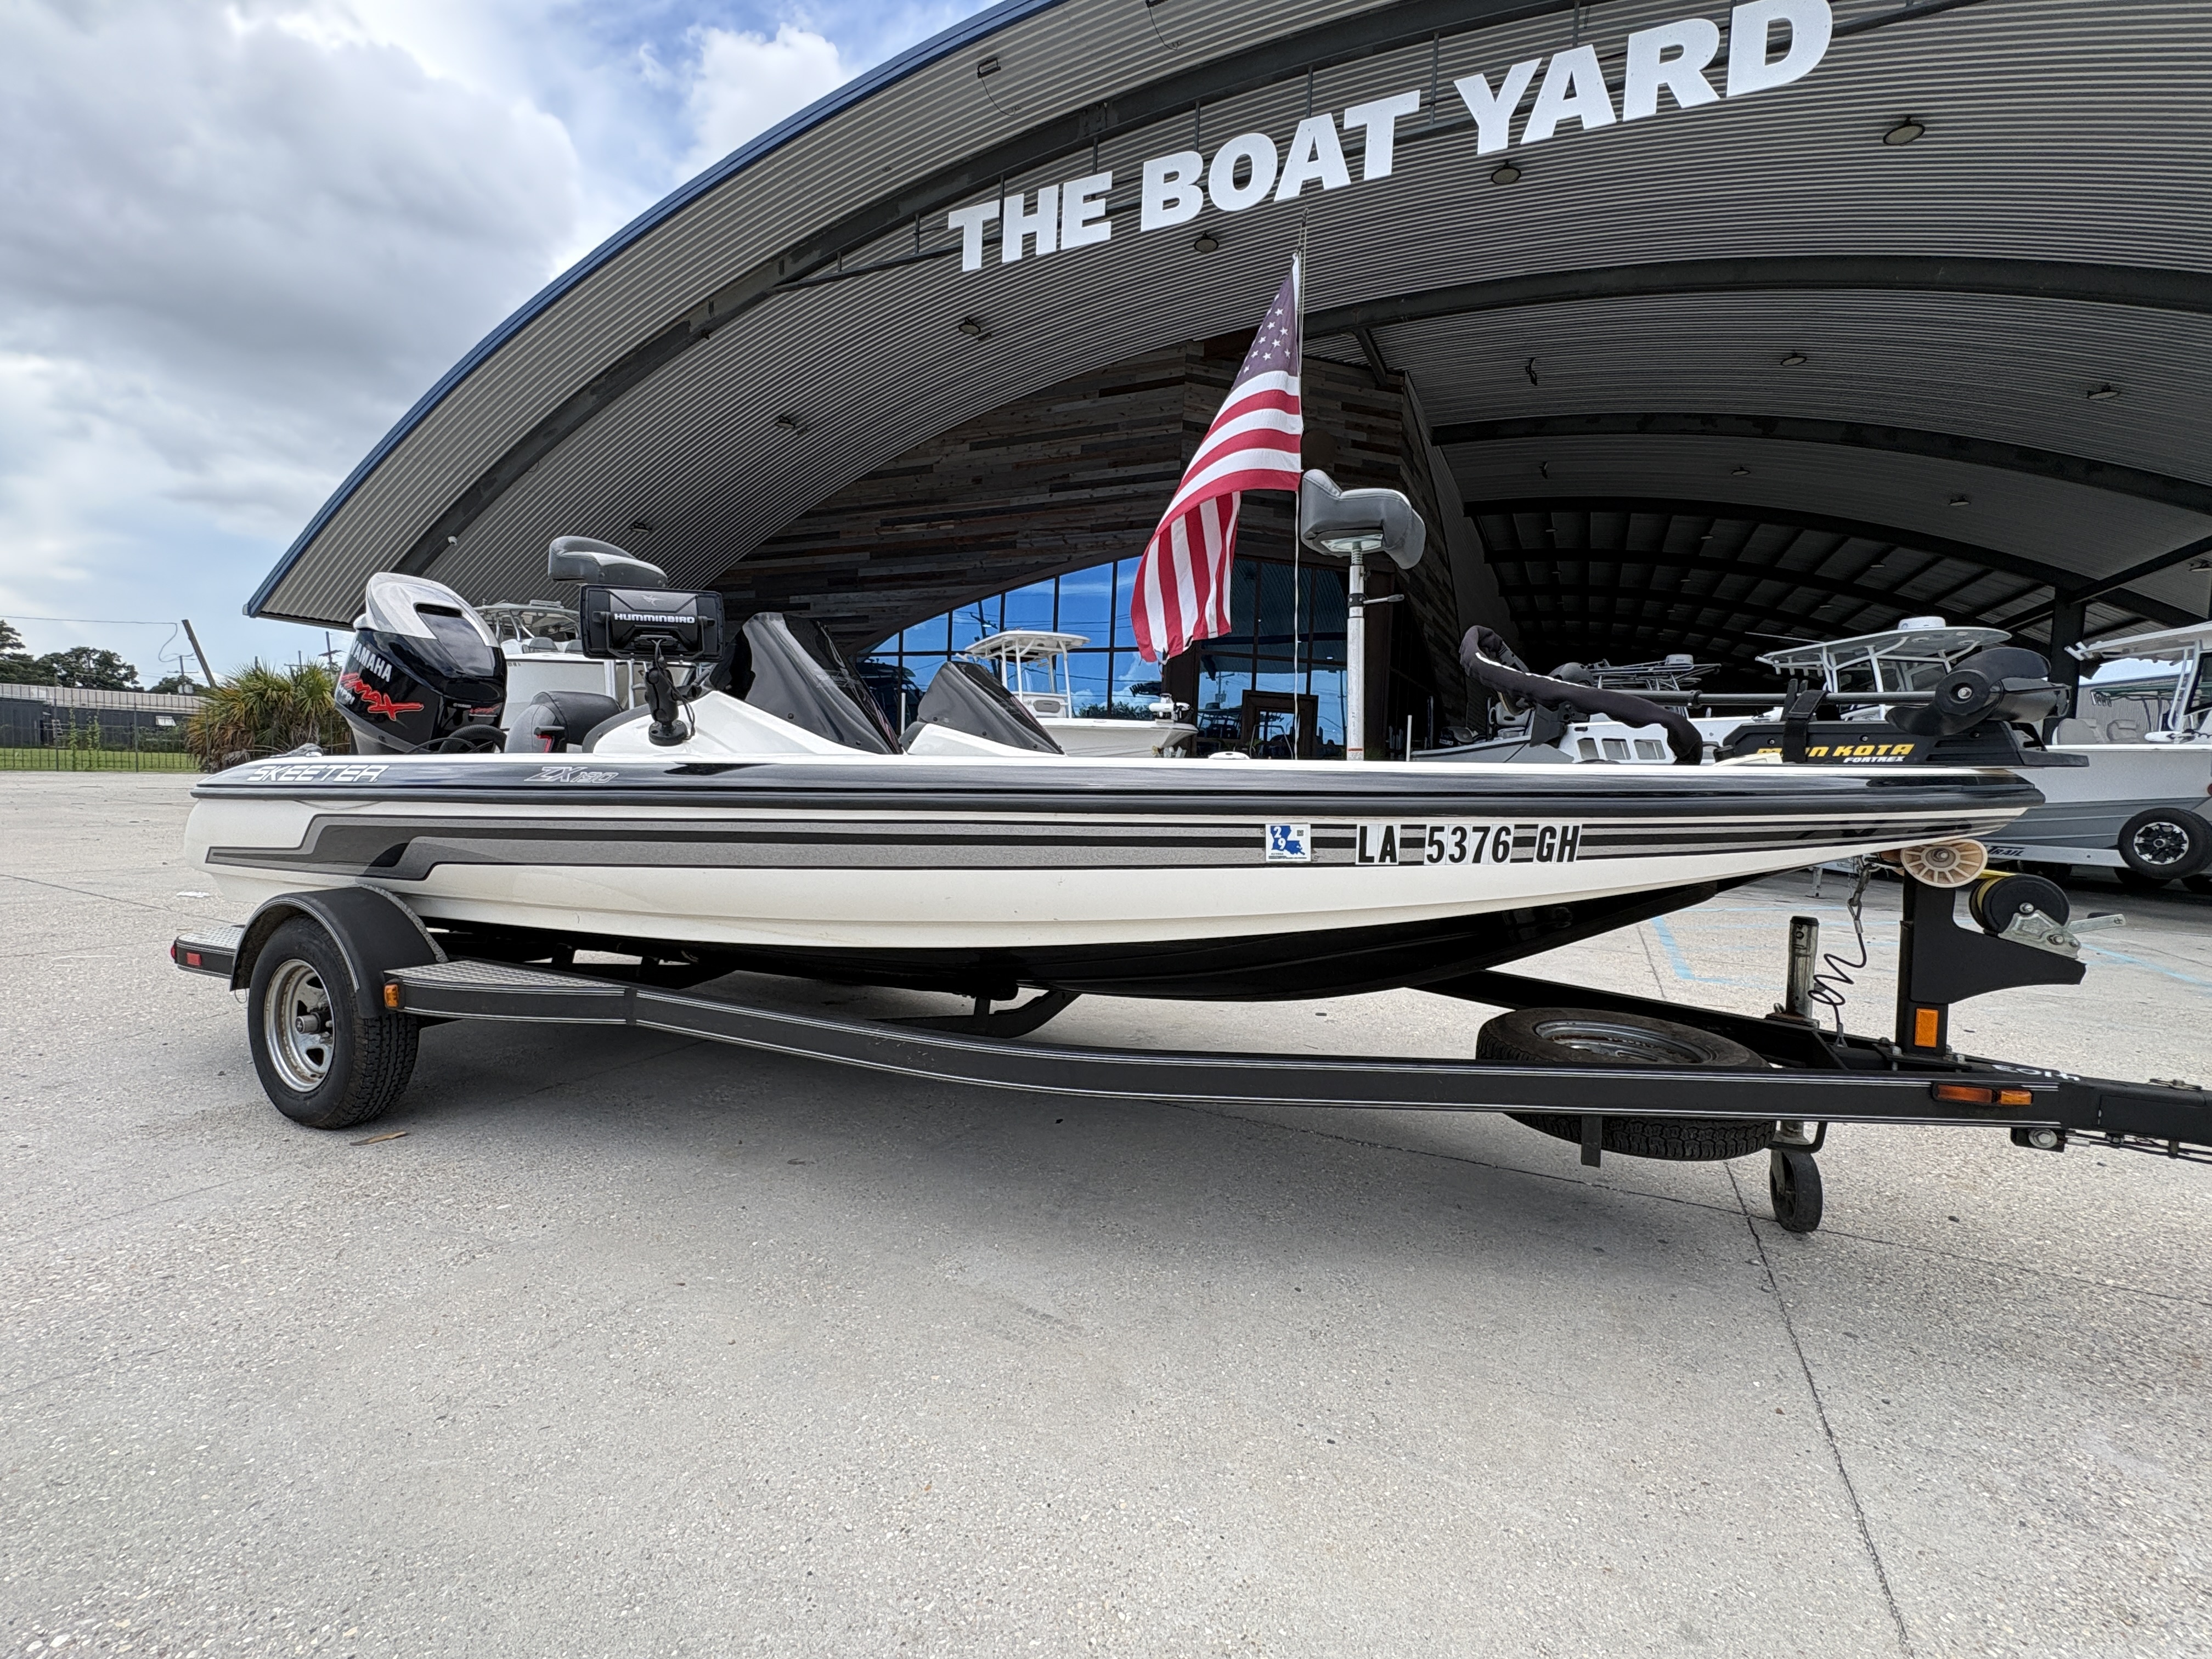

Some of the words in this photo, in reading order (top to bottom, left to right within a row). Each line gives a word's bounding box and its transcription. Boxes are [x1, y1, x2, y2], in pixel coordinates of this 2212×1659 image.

[948, 171, 1113, 272] THE
[1141, 89, 1421, 232] BOAT
[1453, 0, 1833, 155] YARD
[614, 613, 695, 624] HUMMINBIRD
[350, 640, 393, 682] YAMAHA
[1832, 744, 1915, 757] KOTA
[246, 765, 390, 782] SKEETER
[1358, 825, 1398, 864] LA
[1426, 826, 1511, 864] 5376
[1536, 825, 1580, 863] GH
